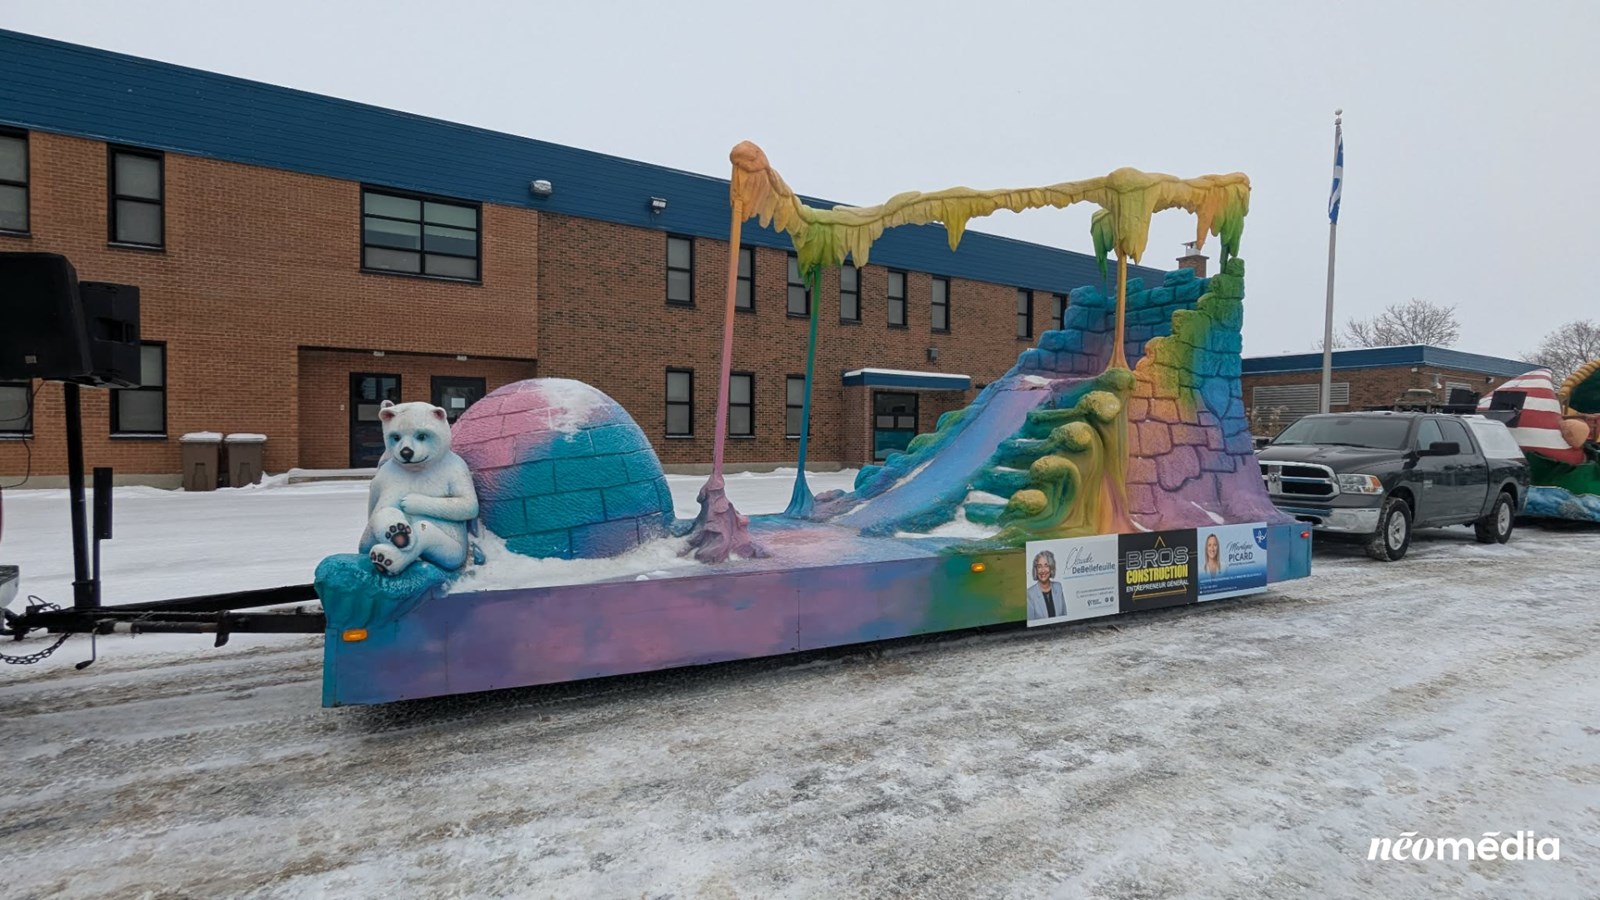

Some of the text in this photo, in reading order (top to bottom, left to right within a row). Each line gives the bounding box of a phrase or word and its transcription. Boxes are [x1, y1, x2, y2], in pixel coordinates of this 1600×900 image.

[1126, 546, 1189, 570] BROS
[1228, 551, 1254, 563] PICARD
[1126, 564, 1189, 584] CONSTRUCTION
[1126, 581, 1167, 593] ENTREPRENEUR
